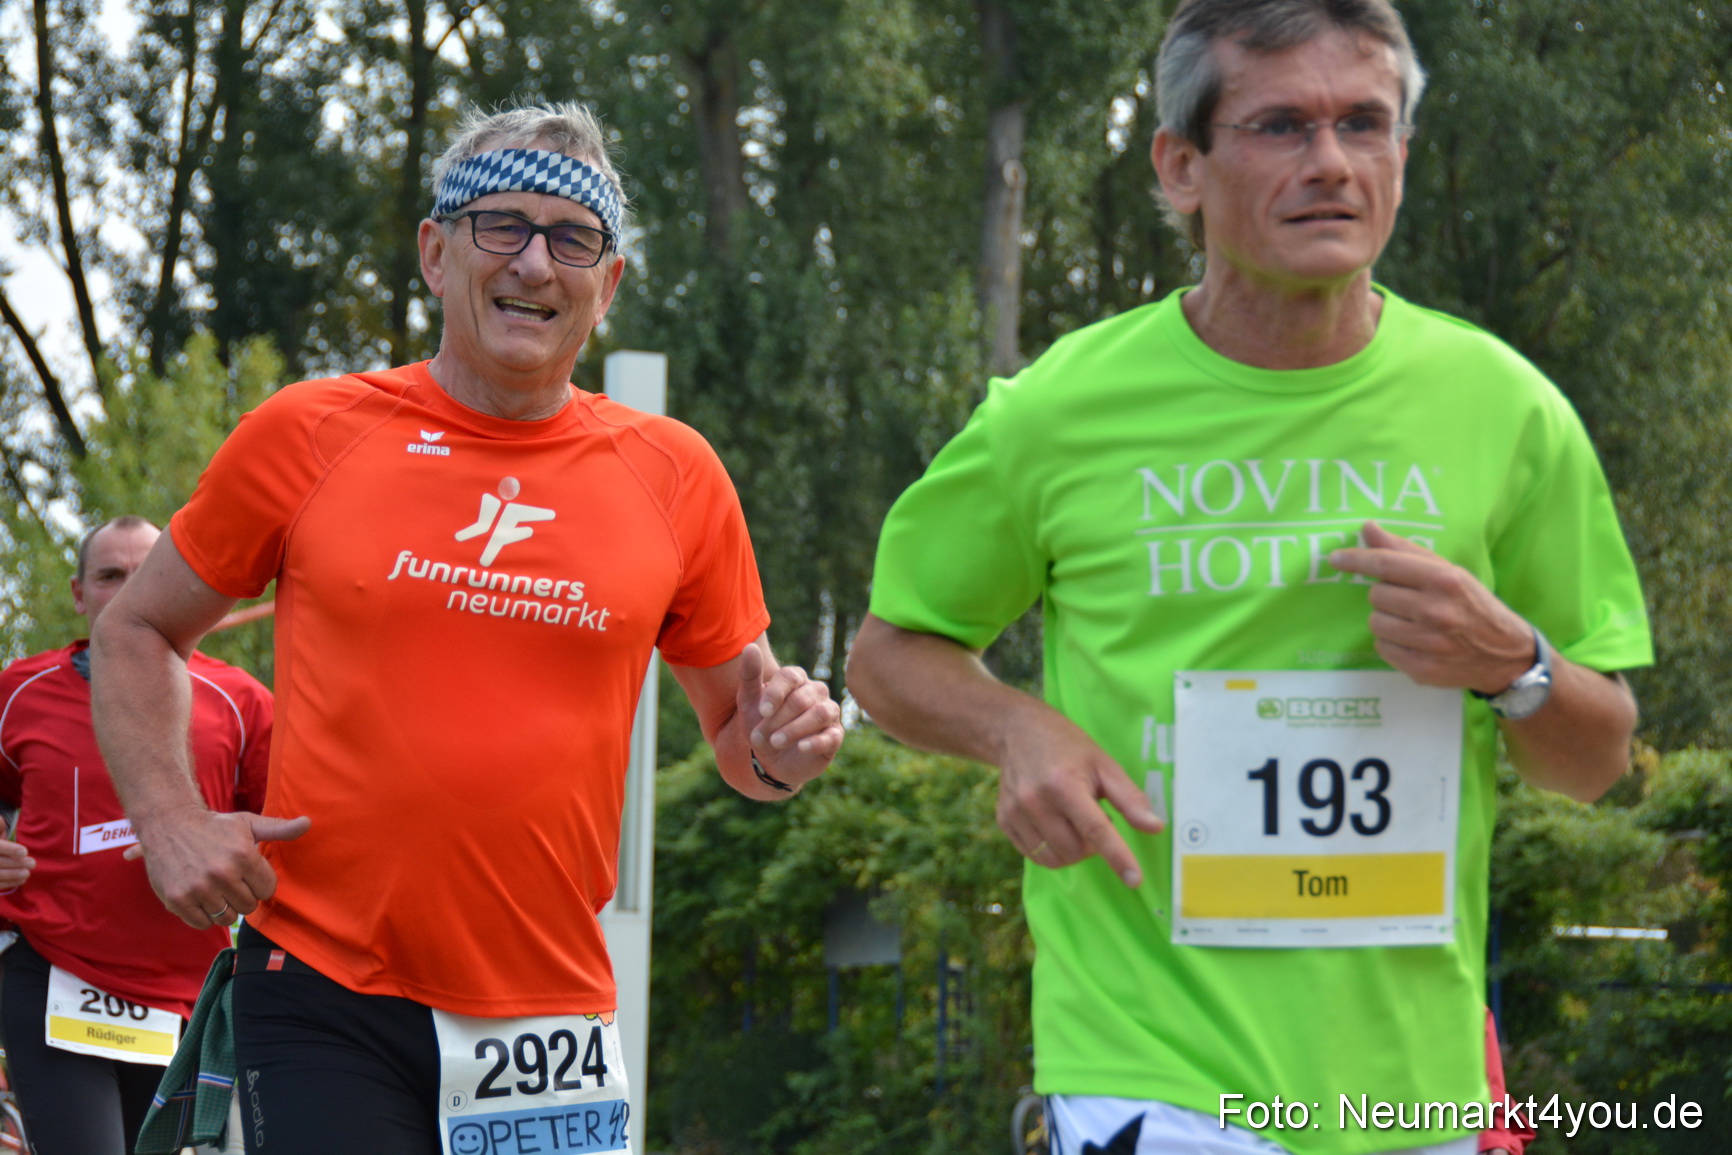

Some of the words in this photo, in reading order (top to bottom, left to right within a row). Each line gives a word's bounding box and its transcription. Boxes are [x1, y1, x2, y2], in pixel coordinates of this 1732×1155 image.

[407, 442, 450, 456] erima
[1135, 458, 1443, 521] NOVINA
[387, 550, 585, 601] funrunners
[1143, 531, 1435, 596] HOTE
[446, 590, 610, 631] neumarkt
[1286, 698, 1381, 719] BOCK
[1247, 757, 1391, 837] 193
[1292, 870, 1348, 897] Tom
[86, 1026, 137, 1045] Rüdiger
[474, 1025, 608, 1100] 2924
[453, 1096, 461, 1107] D
[488, 1110, 602, 1155] PETER
